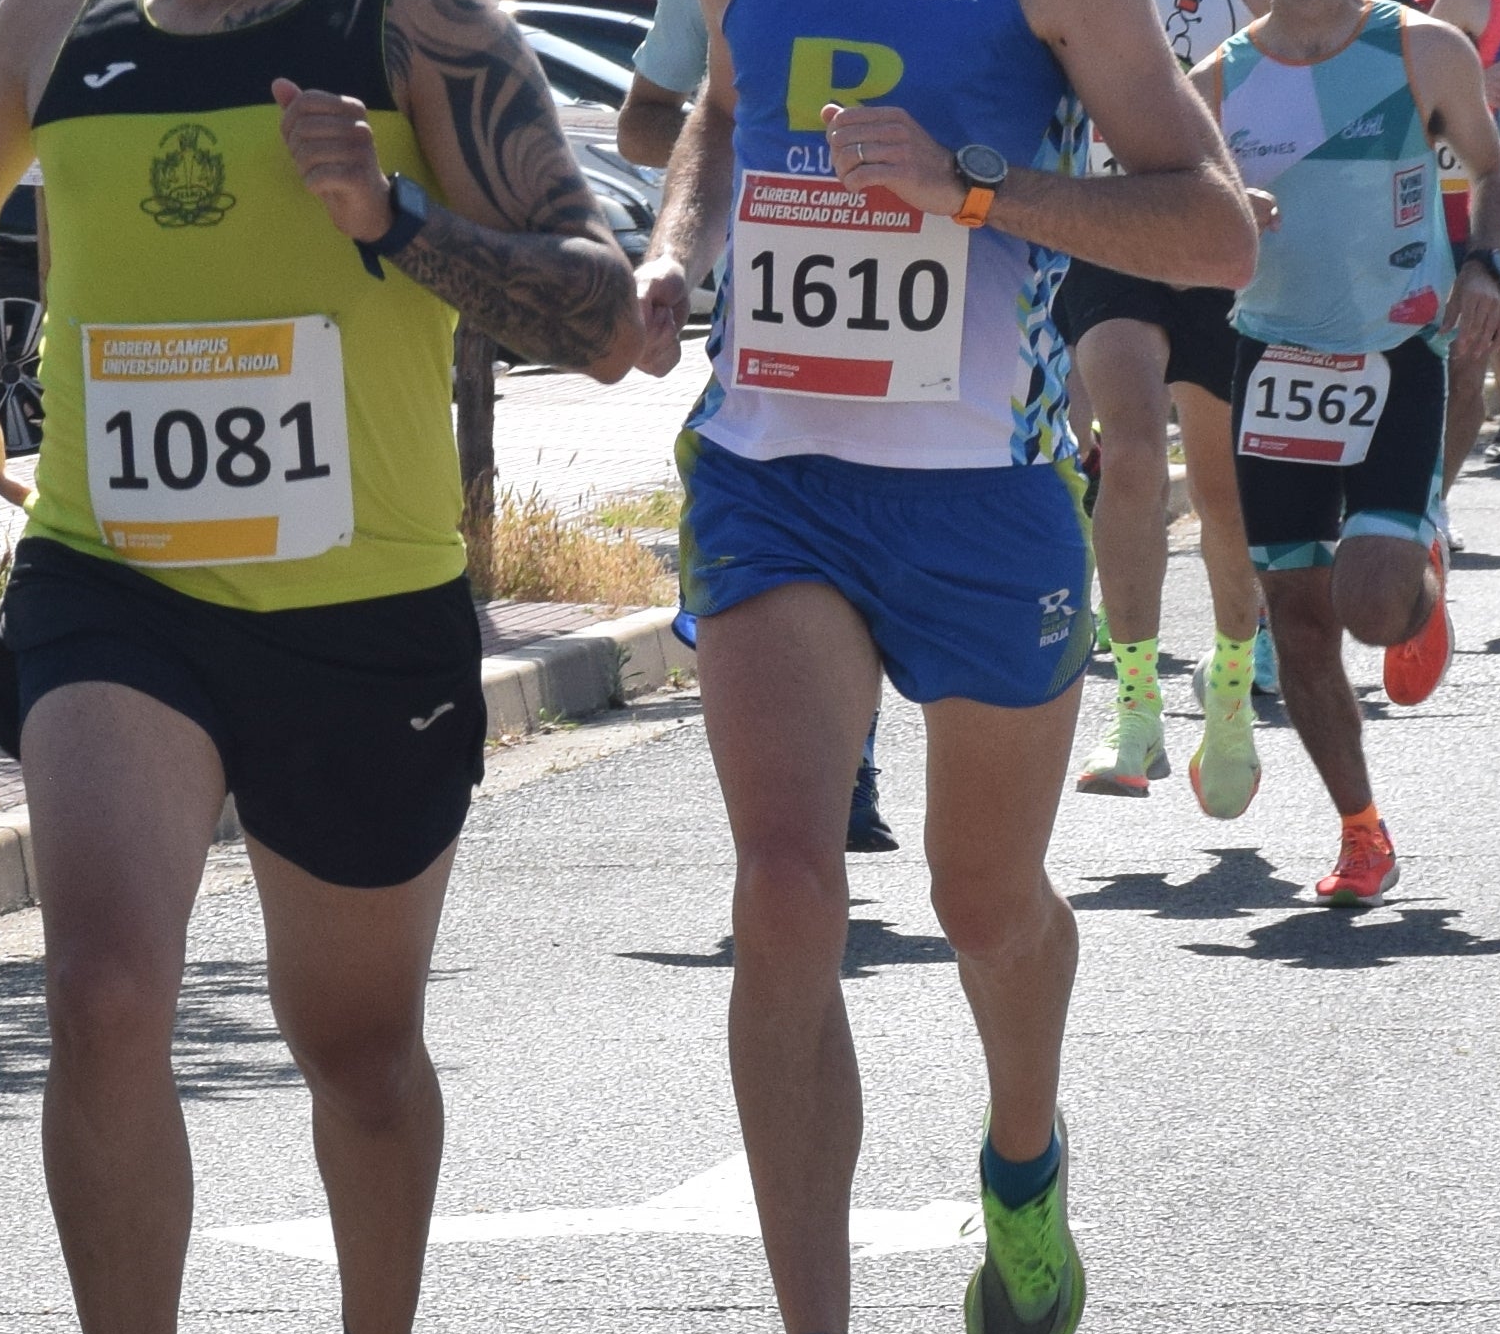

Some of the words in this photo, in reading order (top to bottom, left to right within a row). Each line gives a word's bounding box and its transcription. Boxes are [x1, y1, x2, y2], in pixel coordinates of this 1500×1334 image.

[786, 145, 832, 173] CLU
[753, 186, 807, 204] CARRERA
[810, 190, 866, 207] CAMPUS
[749, 203, 830, 222] UNIVERSIDAD
[832, 208, 850, 224] DE
[852, 210, 869, 225] LA
[872, 211, 911, 227] RIOJA
[751, 250, 949, 332] 1610
[104, 340, 161, 357] CARRERA
[165, 338, 228, 355] CAMPUS
[103, 357, 188, 375] UNIVERSIDAD
[192, 357, 211, 373] DE
[215, 356, 233, 372] LA
[237, 354, 279, 371] RIOJA
[1256, 376, 1377, 427] 1562
[106, 401, 331, 491] 1081
[1040, 627, 1069, 648] RIOJA
